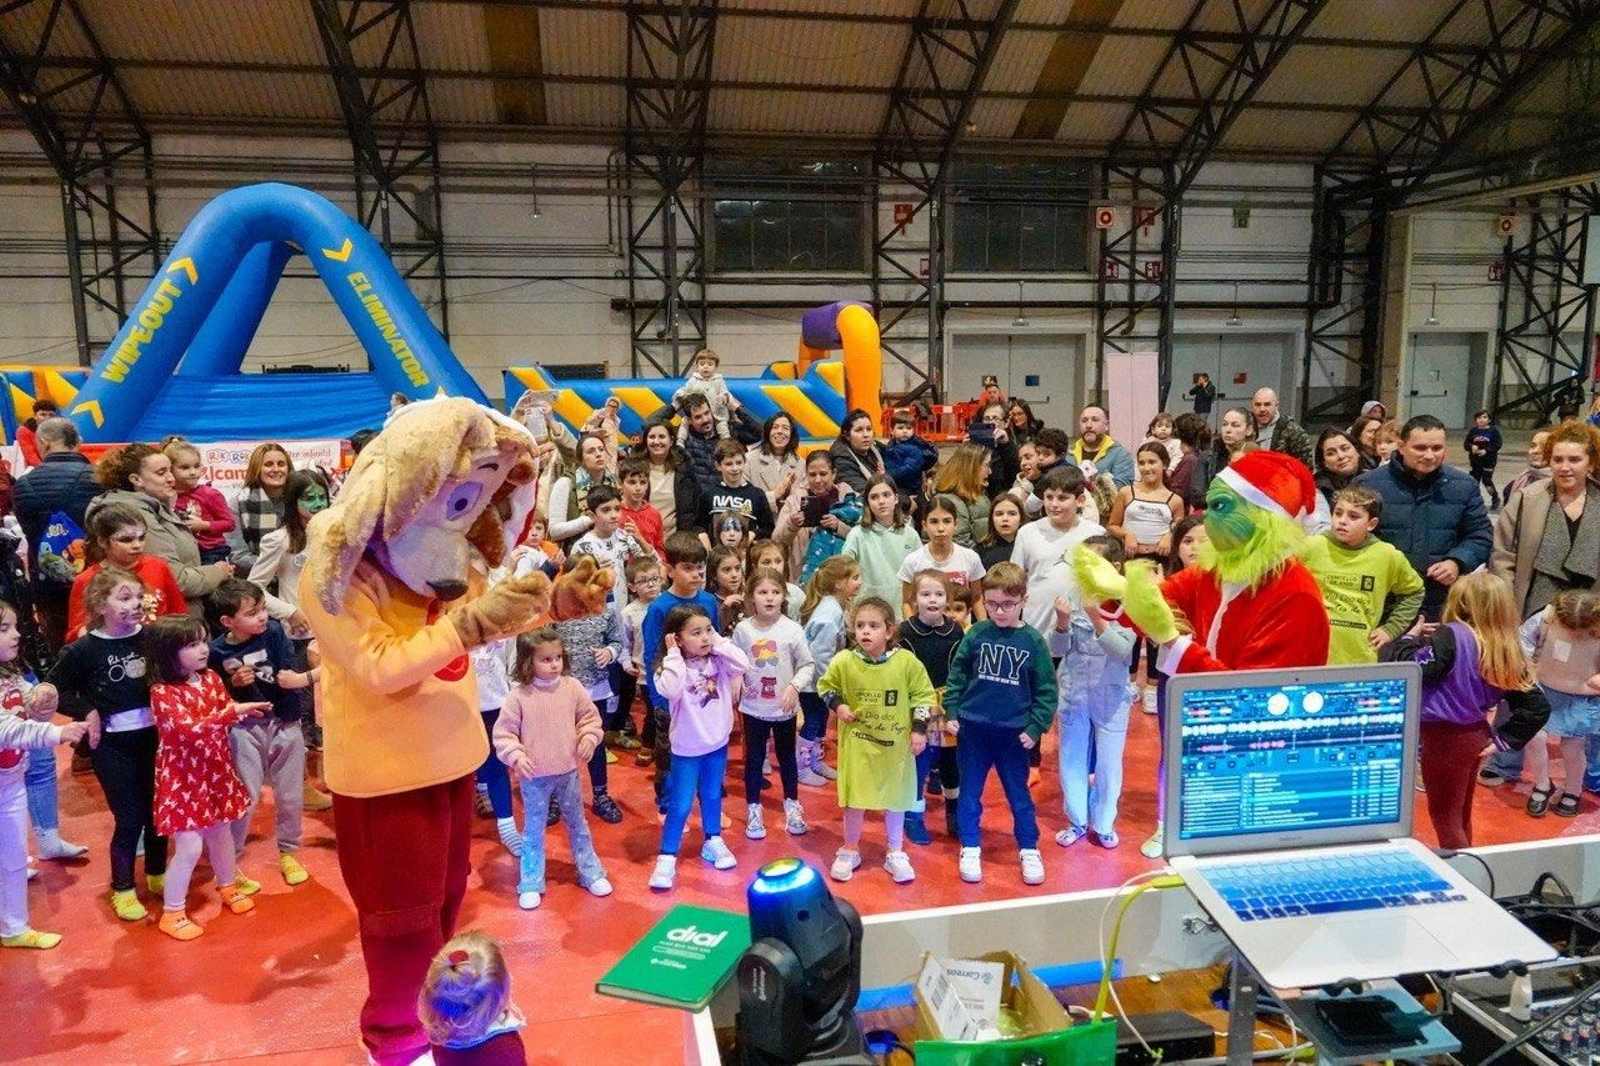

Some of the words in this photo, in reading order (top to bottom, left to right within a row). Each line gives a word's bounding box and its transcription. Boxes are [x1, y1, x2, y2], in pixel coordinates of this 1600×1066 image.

[101, 278, 181, 384] WIPEOUT
[346, 271, 430, 388] ELIMINATOR
[713, 495, 753, 511] NASA
[978, 642, 1030, 680] NY
[666, 925, 729, 948] dial
[946, 968, 980, 981] Correos
